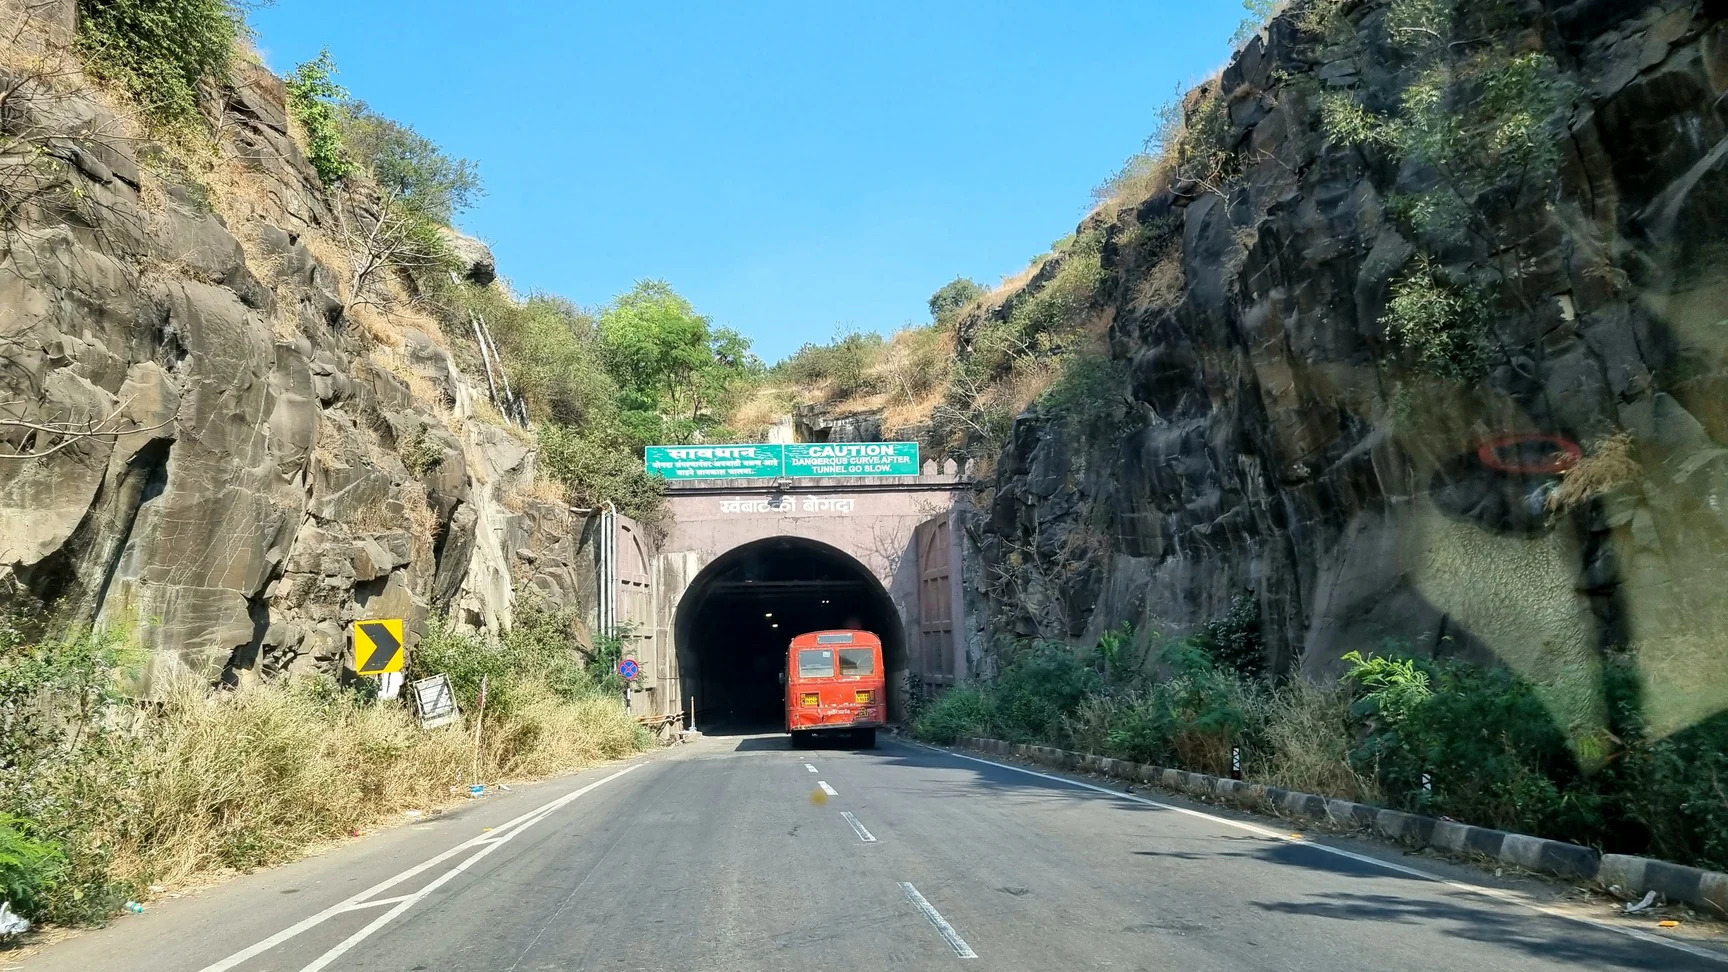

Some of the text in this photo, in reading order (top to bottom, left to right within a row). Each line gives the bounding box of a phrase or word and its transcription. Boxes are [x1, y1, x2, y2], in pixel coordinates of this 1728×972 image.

[666, 447, 756, 459] सावधान
[809, 445, 895, 457] CAUTION
[792, 455, 910, 466] DANGEROUS CURVE AFTER
[812, 465, 847, 473] TUNNEL
[848, 464, 863, 472] GO
[802, 495, 856, 513] बोगदा
